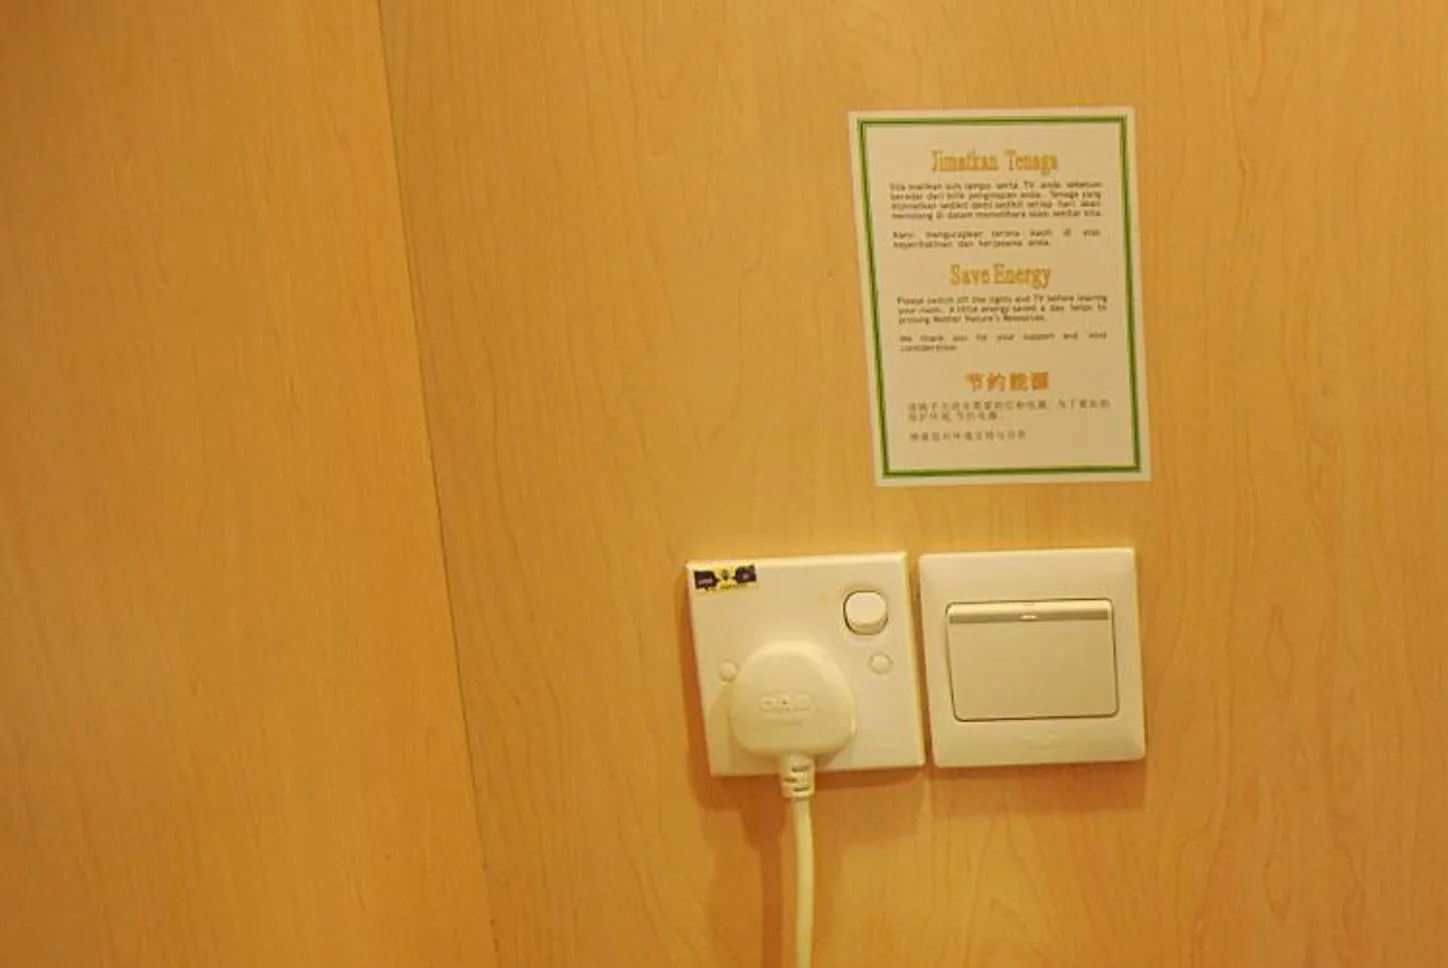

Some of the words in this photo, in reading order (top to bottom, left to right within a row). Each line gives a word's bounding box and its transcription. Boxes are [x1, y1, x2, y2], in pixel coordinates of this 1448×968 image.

[931, 150, 998, 172] Jimatkan
[1007, 150, 1058, 173] Tenaga
[950, 265, 989, 285] Save
[994, 264, 1052, 288] Energy
[966, 373, 1049, 391] 节约能源
